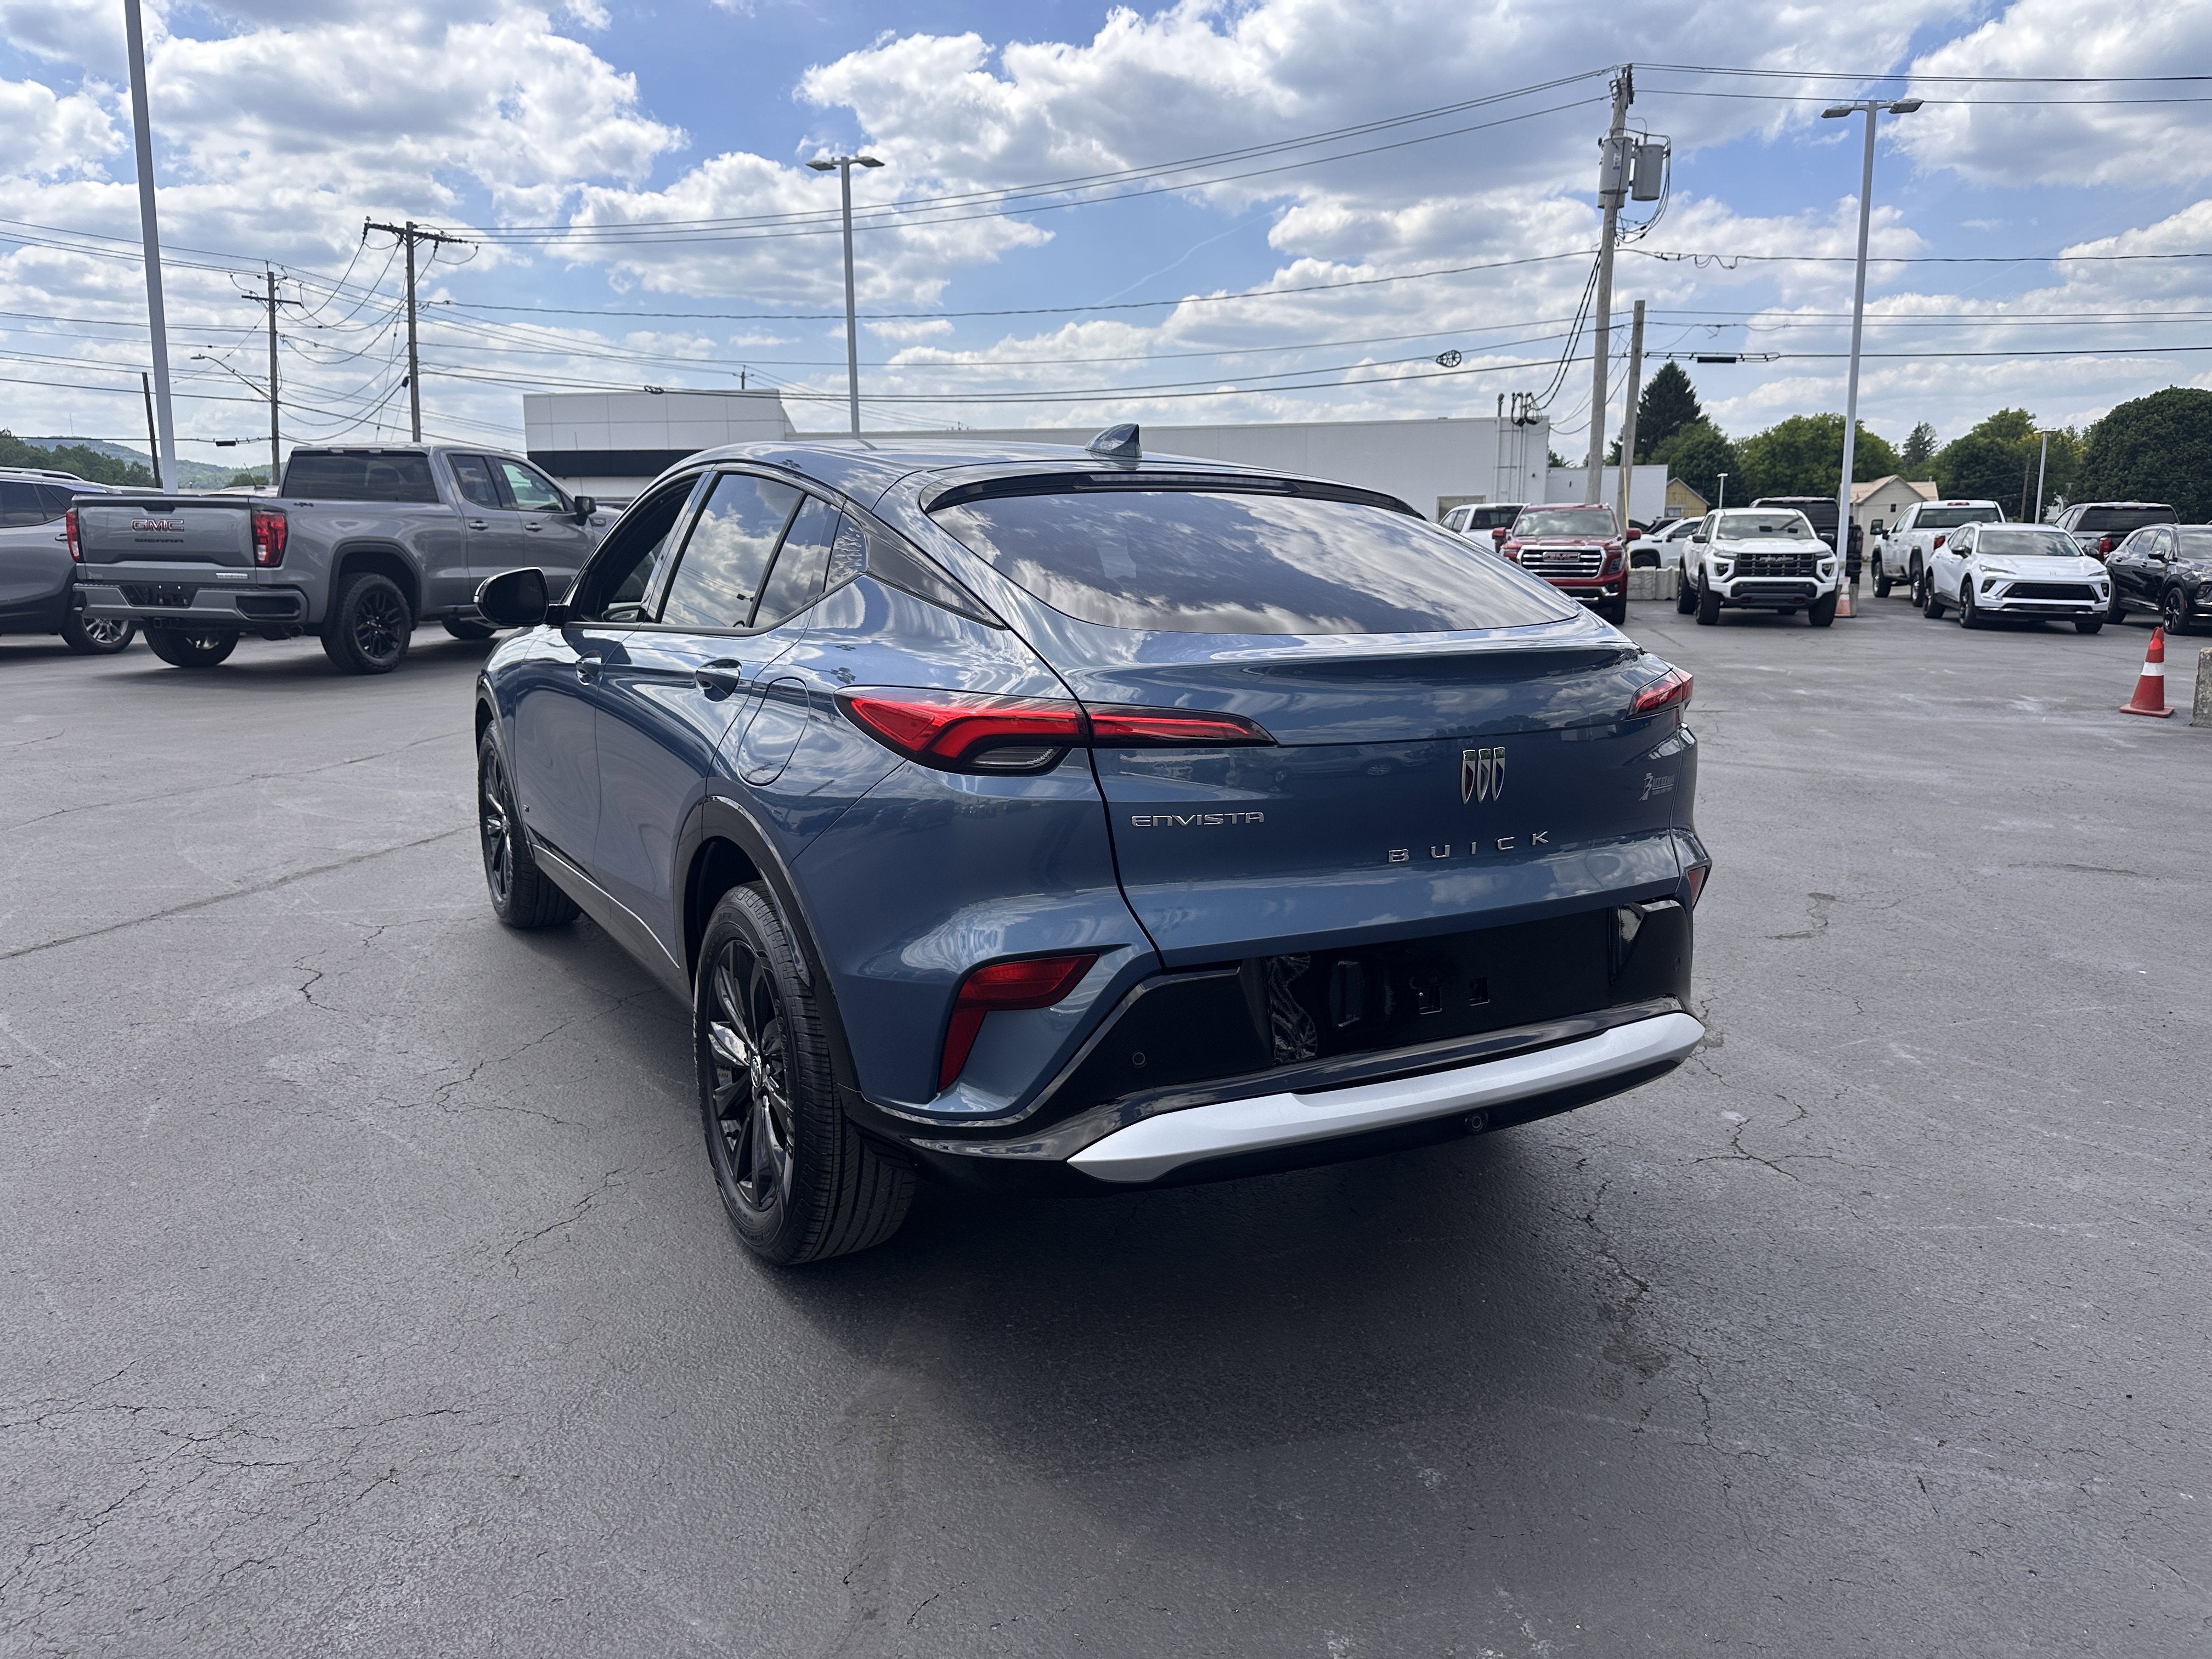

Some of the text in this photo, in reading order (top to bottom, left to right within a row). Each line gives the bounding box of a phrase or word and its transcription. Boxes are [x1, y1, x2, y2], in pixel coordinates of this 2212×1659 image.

[131, 518, 184, 532] GMC
[1131, 812, 1265, 827] ENVISTA
[1388, 831, 1549, 863] BUICK
